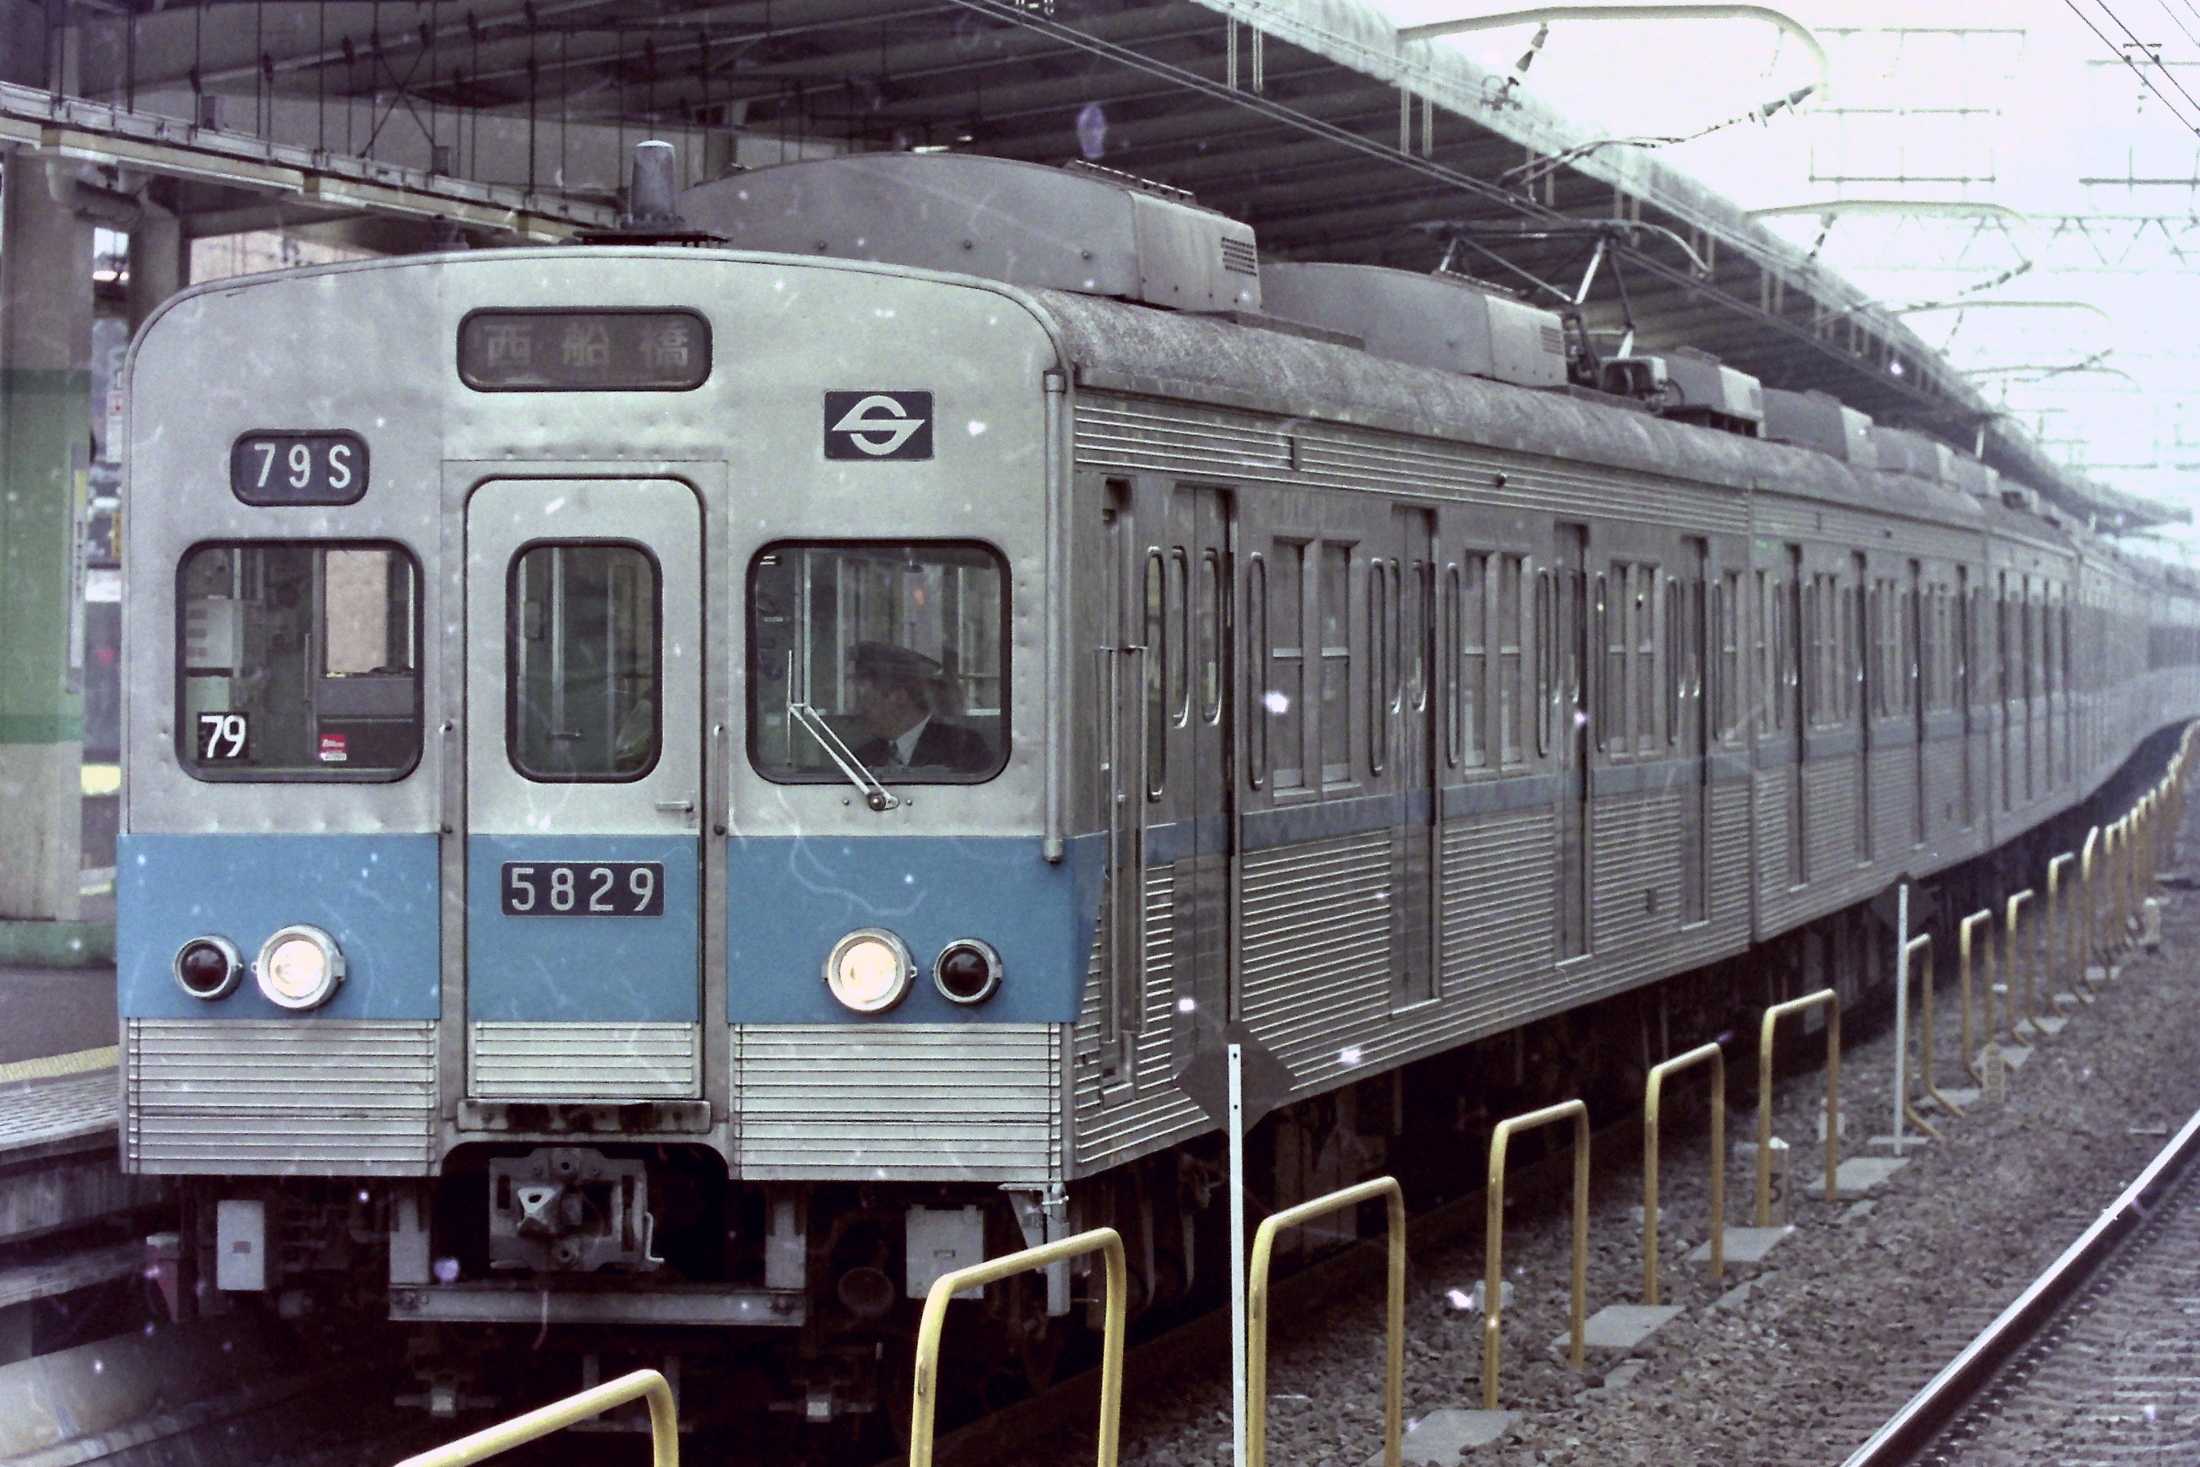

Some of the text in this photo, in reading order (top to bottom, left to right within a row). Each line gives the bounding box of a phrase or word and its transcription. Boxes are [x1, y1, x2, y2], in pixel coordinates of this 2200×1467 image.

[254, 443, 351, 488] 79S
[201, 715, 246, 758] 79
[511, 867, 654, 911] 5829
